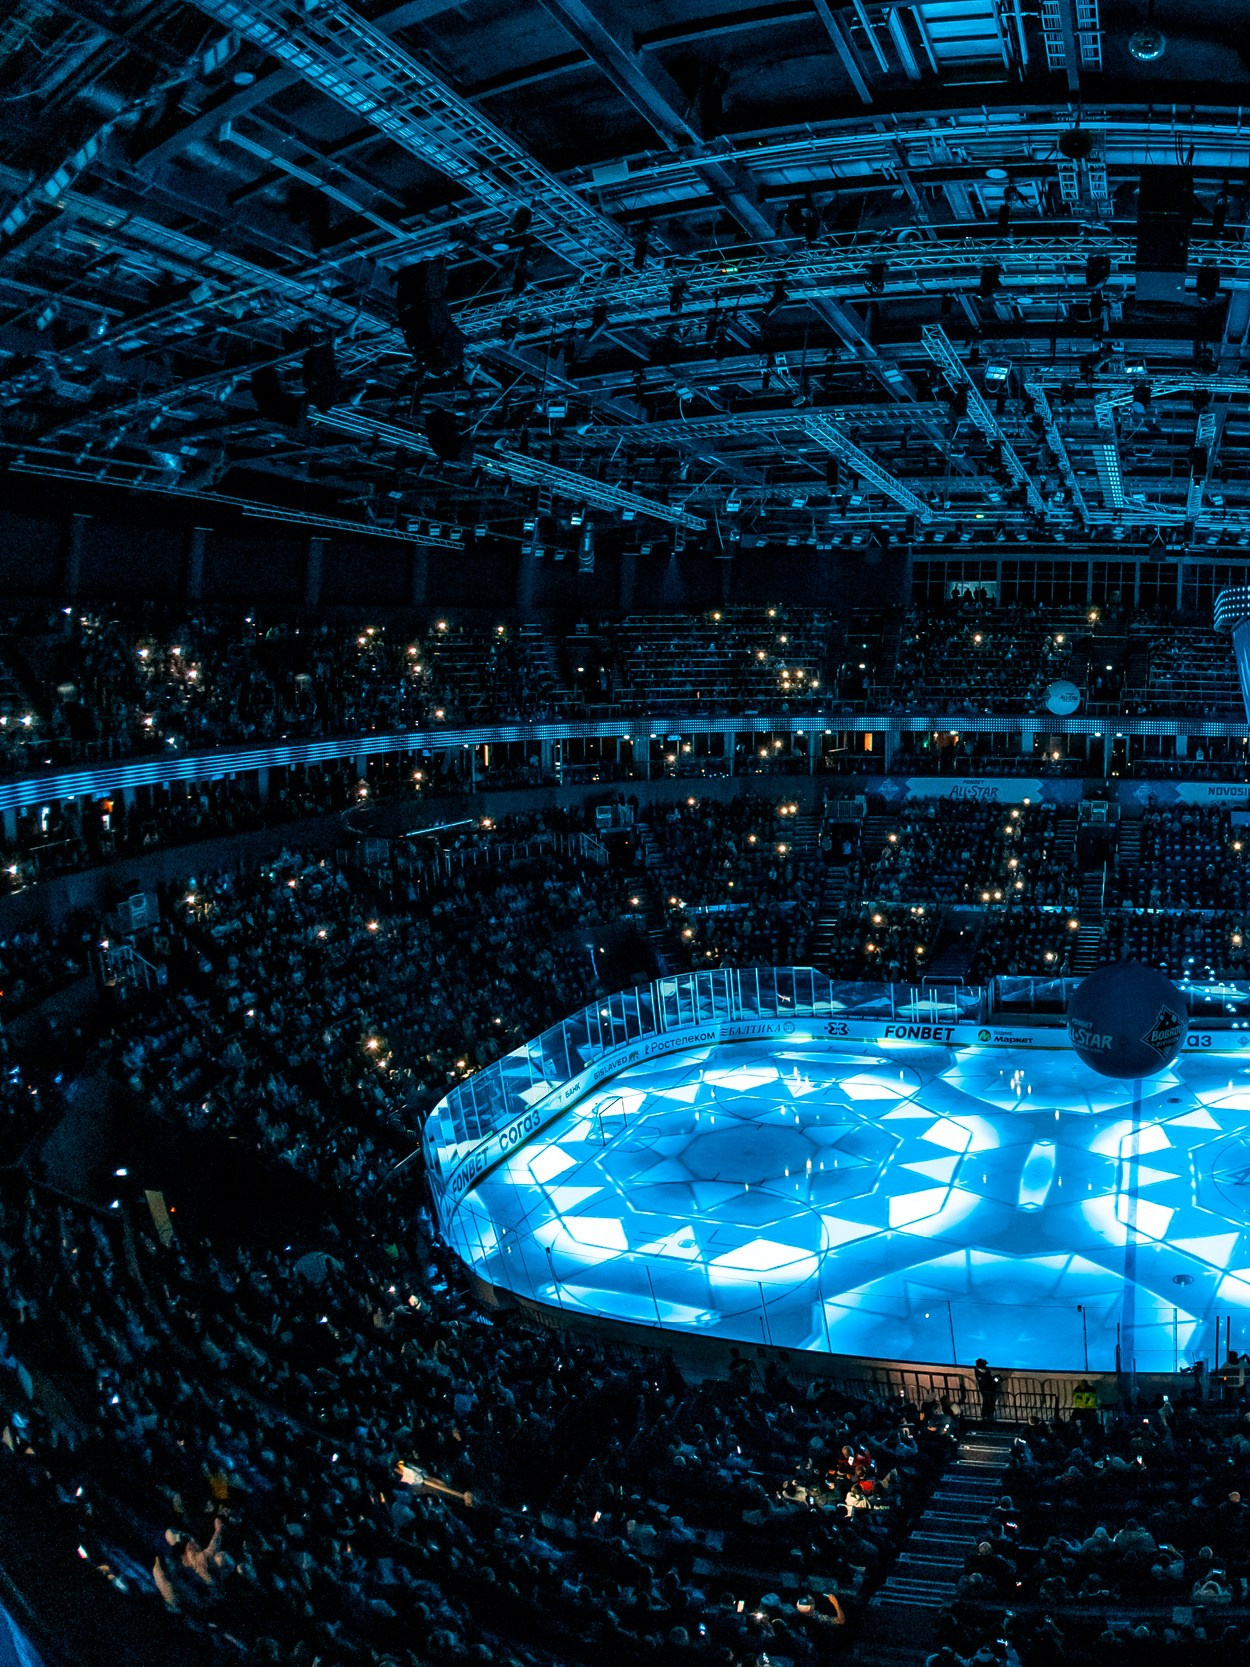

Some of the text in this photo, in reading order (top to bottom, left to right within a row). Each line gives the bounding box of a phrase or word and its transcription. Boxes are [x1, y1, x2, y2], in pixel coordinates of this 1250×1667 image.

[728, 1023, 781, 1036] БАЛТИКА
[885, 1025, 955, 1041] FONBET
[651, 1031, 716, 1053] Ростелеком
[993, 1036, 1033, 1044] Маркет
[593, 1057, 628, 1080] GISLAVED
[564, 1082, 581, 1099] БАНК
[452, 1146, 489, 1193] FONBET
